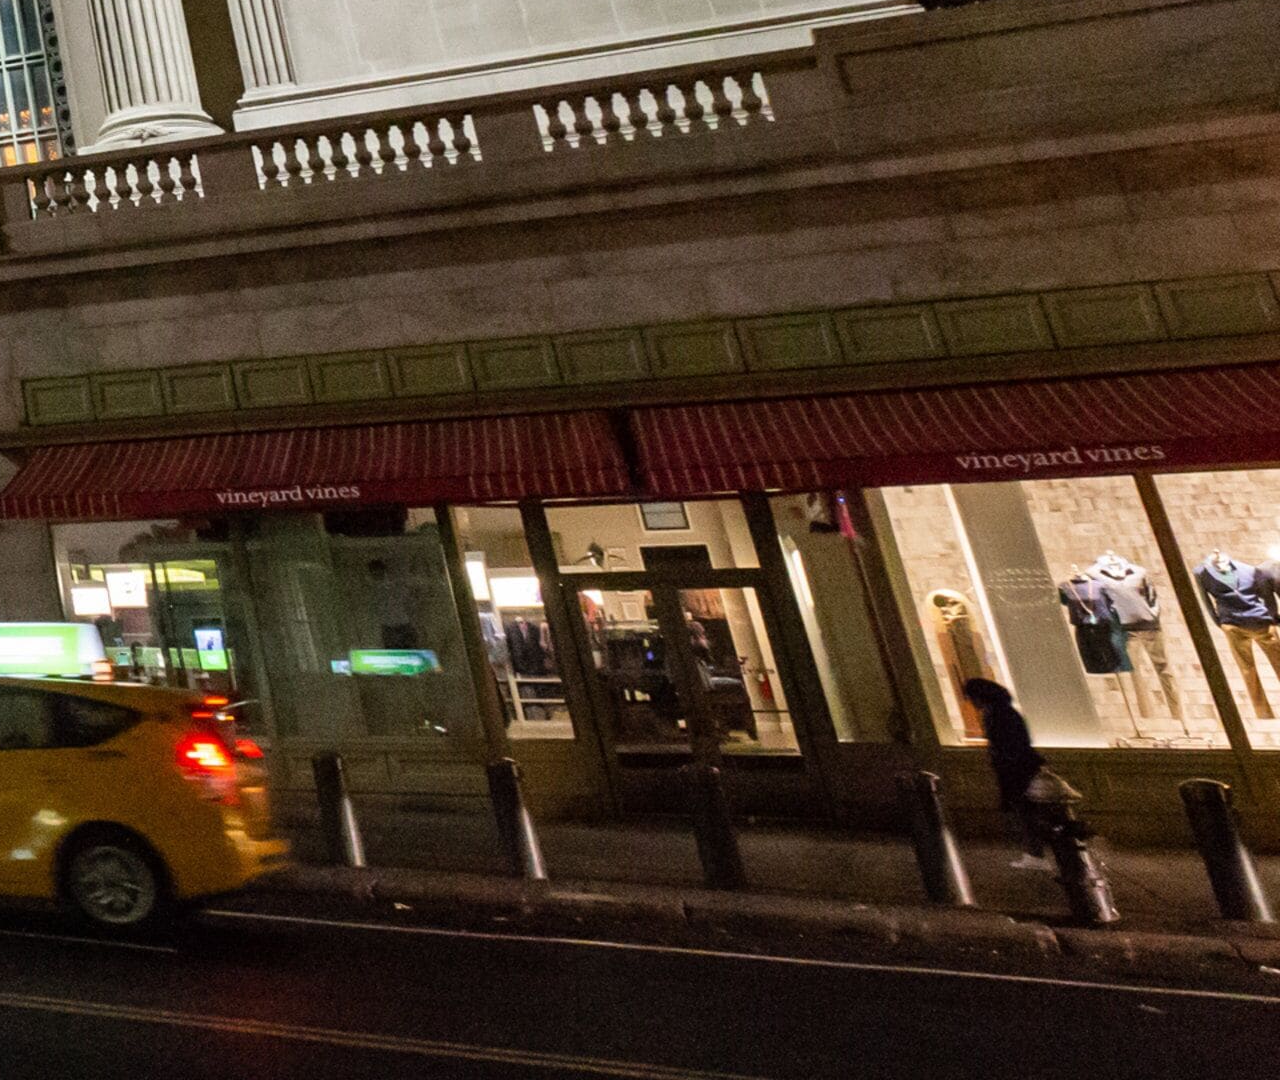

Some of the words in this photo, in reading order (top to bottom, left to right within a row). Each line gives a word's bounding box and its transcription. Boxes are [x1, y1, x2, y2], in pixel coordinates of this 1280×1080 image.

[955, 446, 1083, 472] vineyard
[1084, 444, 1166, 463] vines
[216, 485, 303, 508] vineyard
[305, 483, 361, 500] vines
